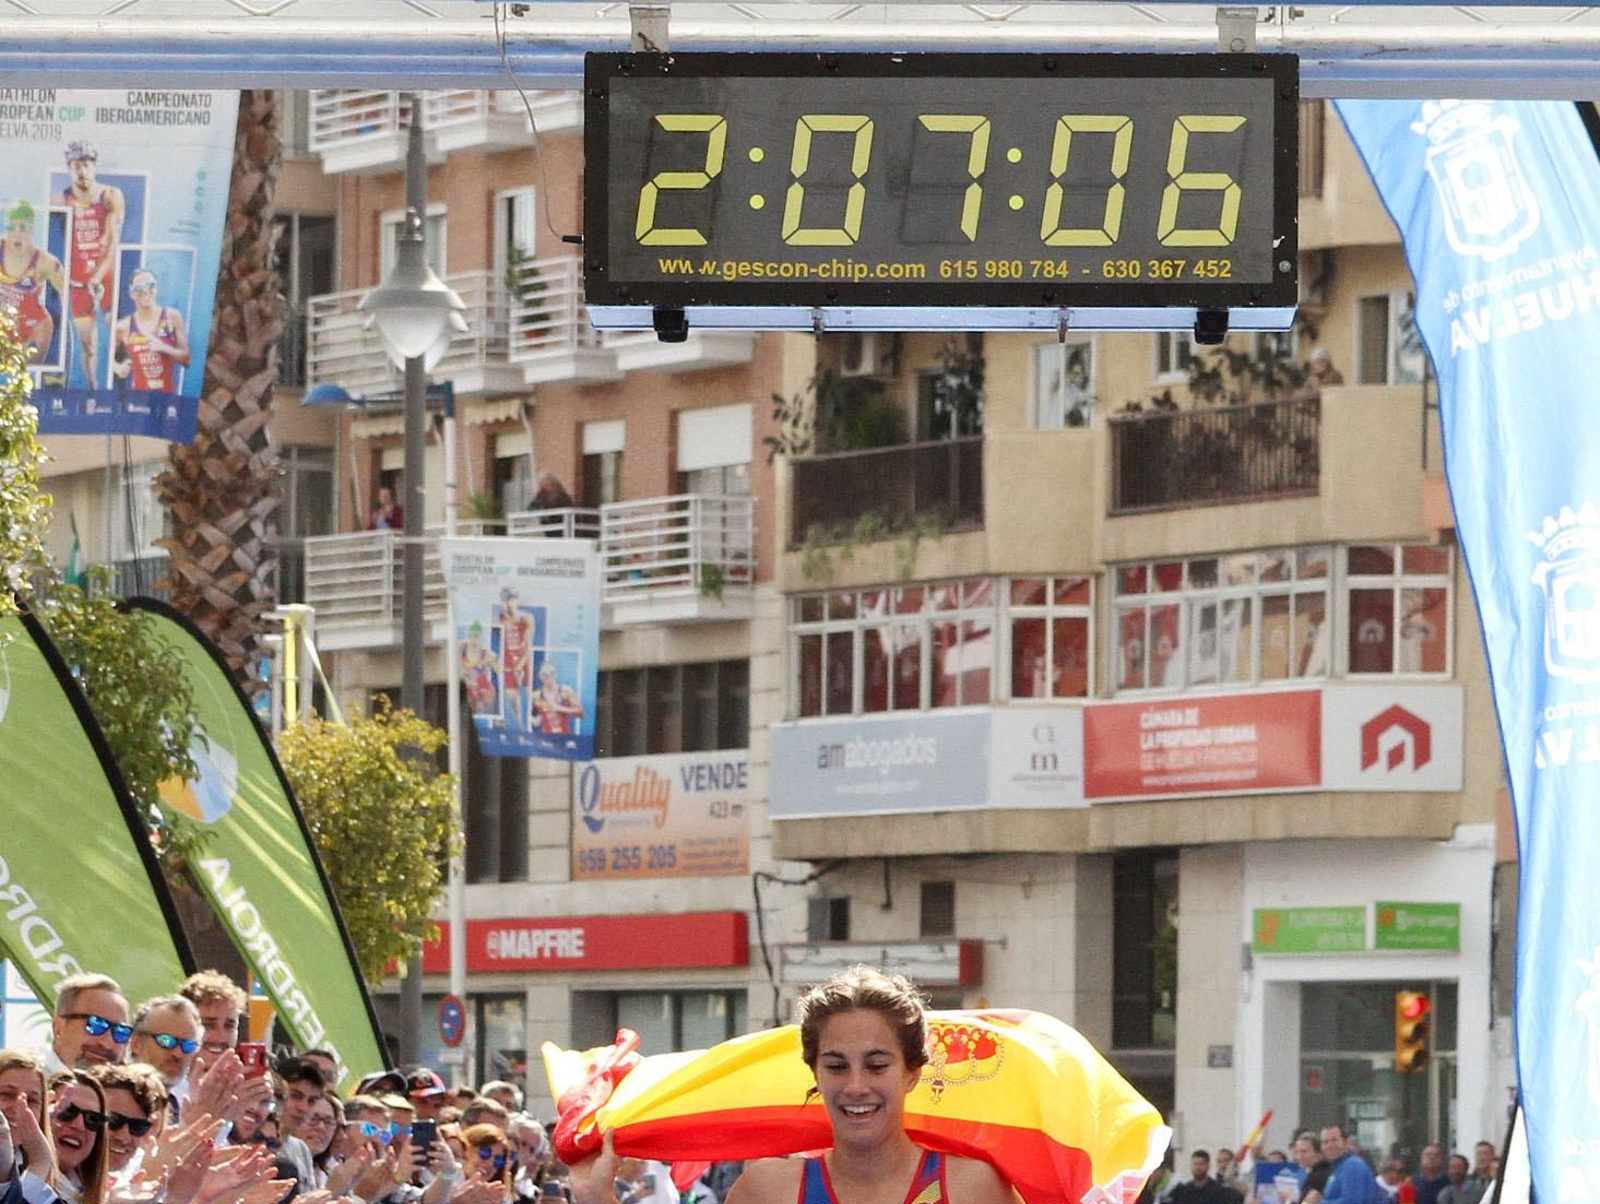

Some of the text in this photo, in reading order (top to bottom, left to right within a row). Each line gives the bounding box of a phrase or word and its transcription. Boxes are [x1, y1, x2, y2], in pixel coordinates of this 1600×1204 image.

[127, 91, 212, 108] CAMPEONATO
[58, 106, 87, 123] CUP
[96, 107, 211, 126] IBEROAMERICANO
[32, 123, 62, 141] 2019
[635, 114, 1247, 246] 2:07:06
[938, 260, 977, 279] 615
[985, 260, 1023, 279] 980
[1030, 260, 1069, 279] 784
[1102, 260, 1141, 279] 630
[1148, 259, 1186, 279] 367
[1193, 259, 1232, 279] 452
[817, 731, 938, 775] amabogados
[682, 763, 748, 792] VENDE
[580, 765, 672, 830] Quality
[500, 928, 586, 959] MAPFRE
